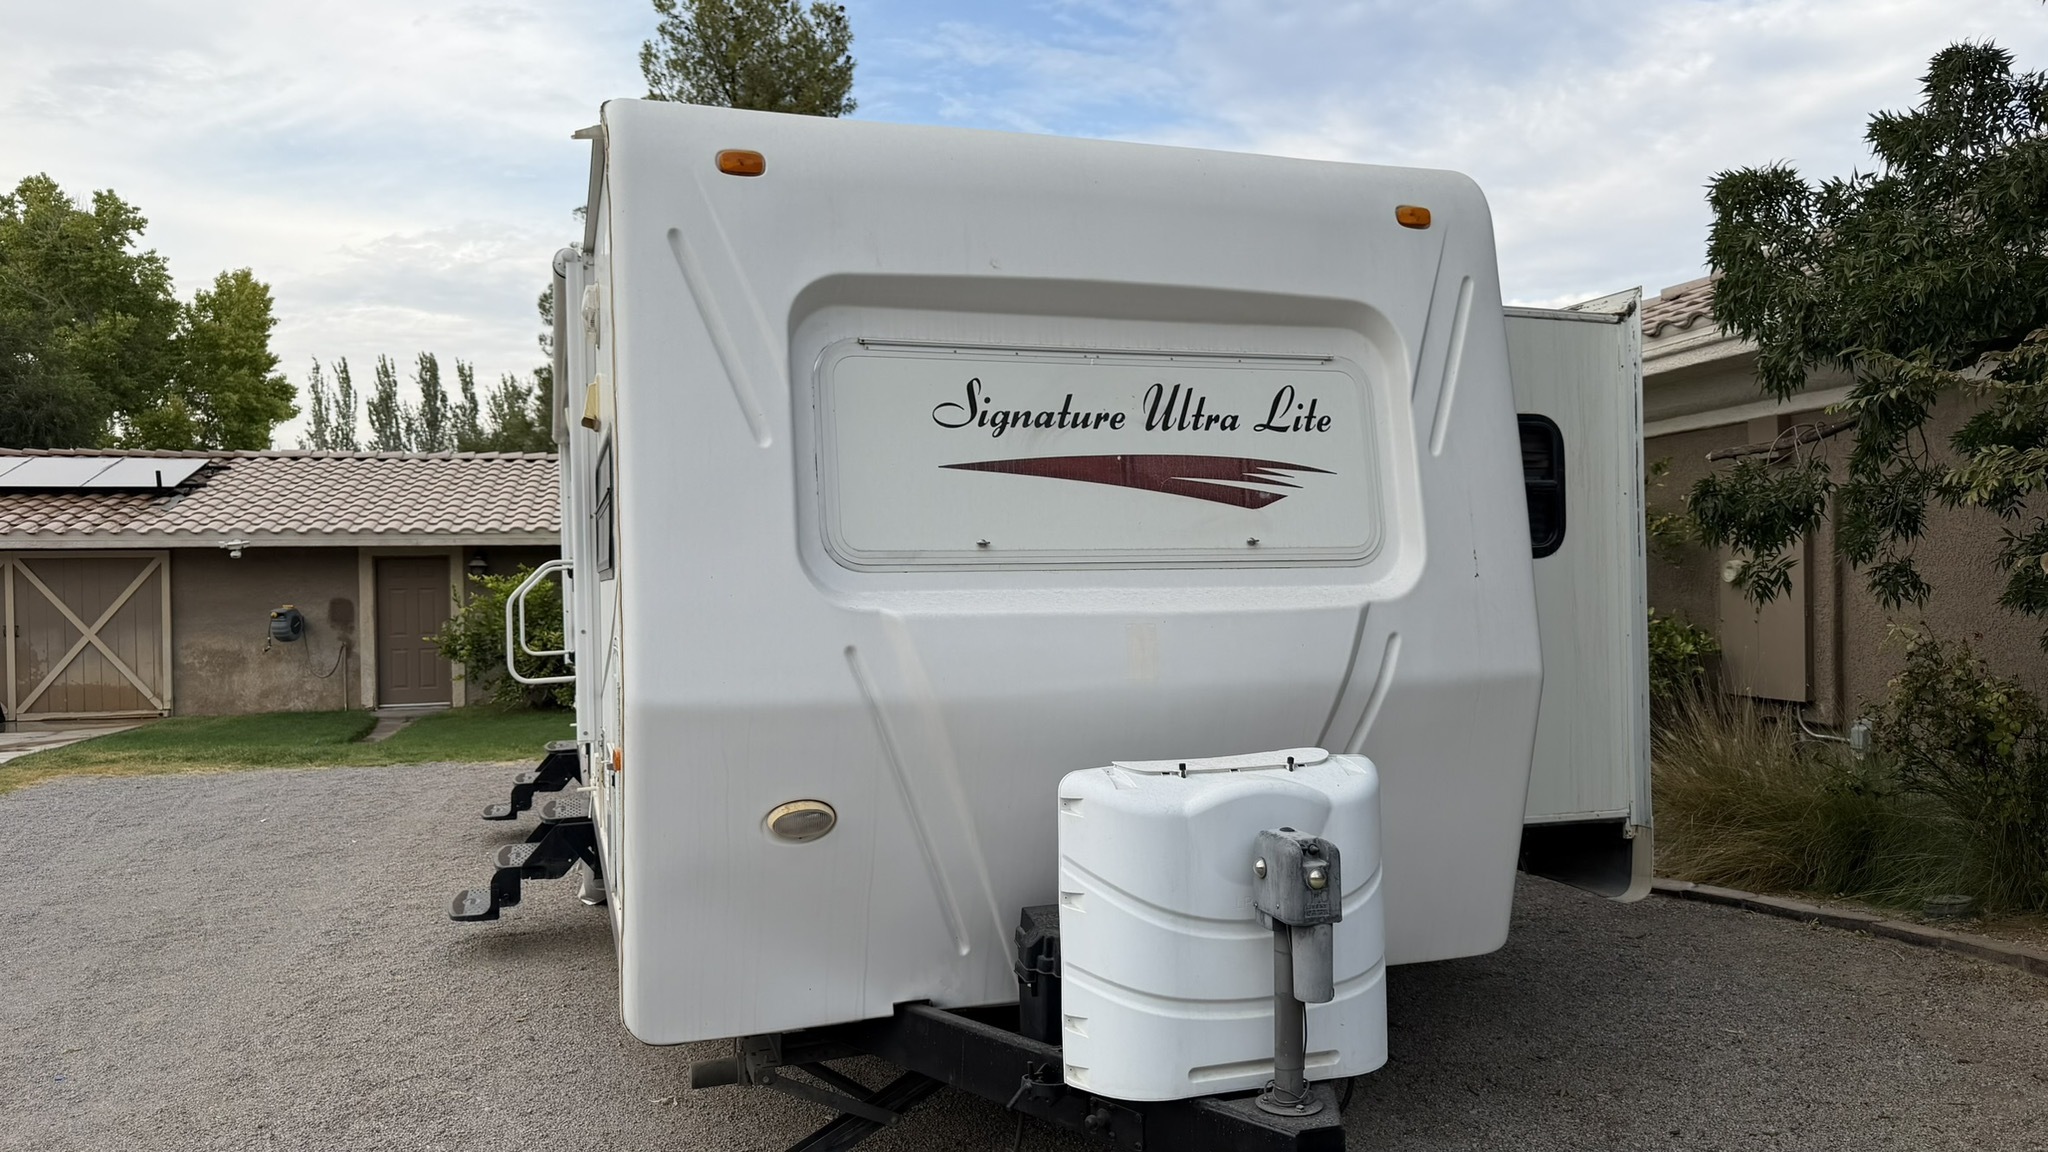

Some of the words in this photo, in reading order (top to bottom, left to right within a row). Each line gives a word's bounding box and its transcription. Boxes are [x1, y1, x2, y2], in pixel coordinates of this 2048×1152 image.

[932, 377, 1126, 438] Signature
[1142, 382, 1241, 432] Ultra
[1253, 384, 1332, 433] Lite
